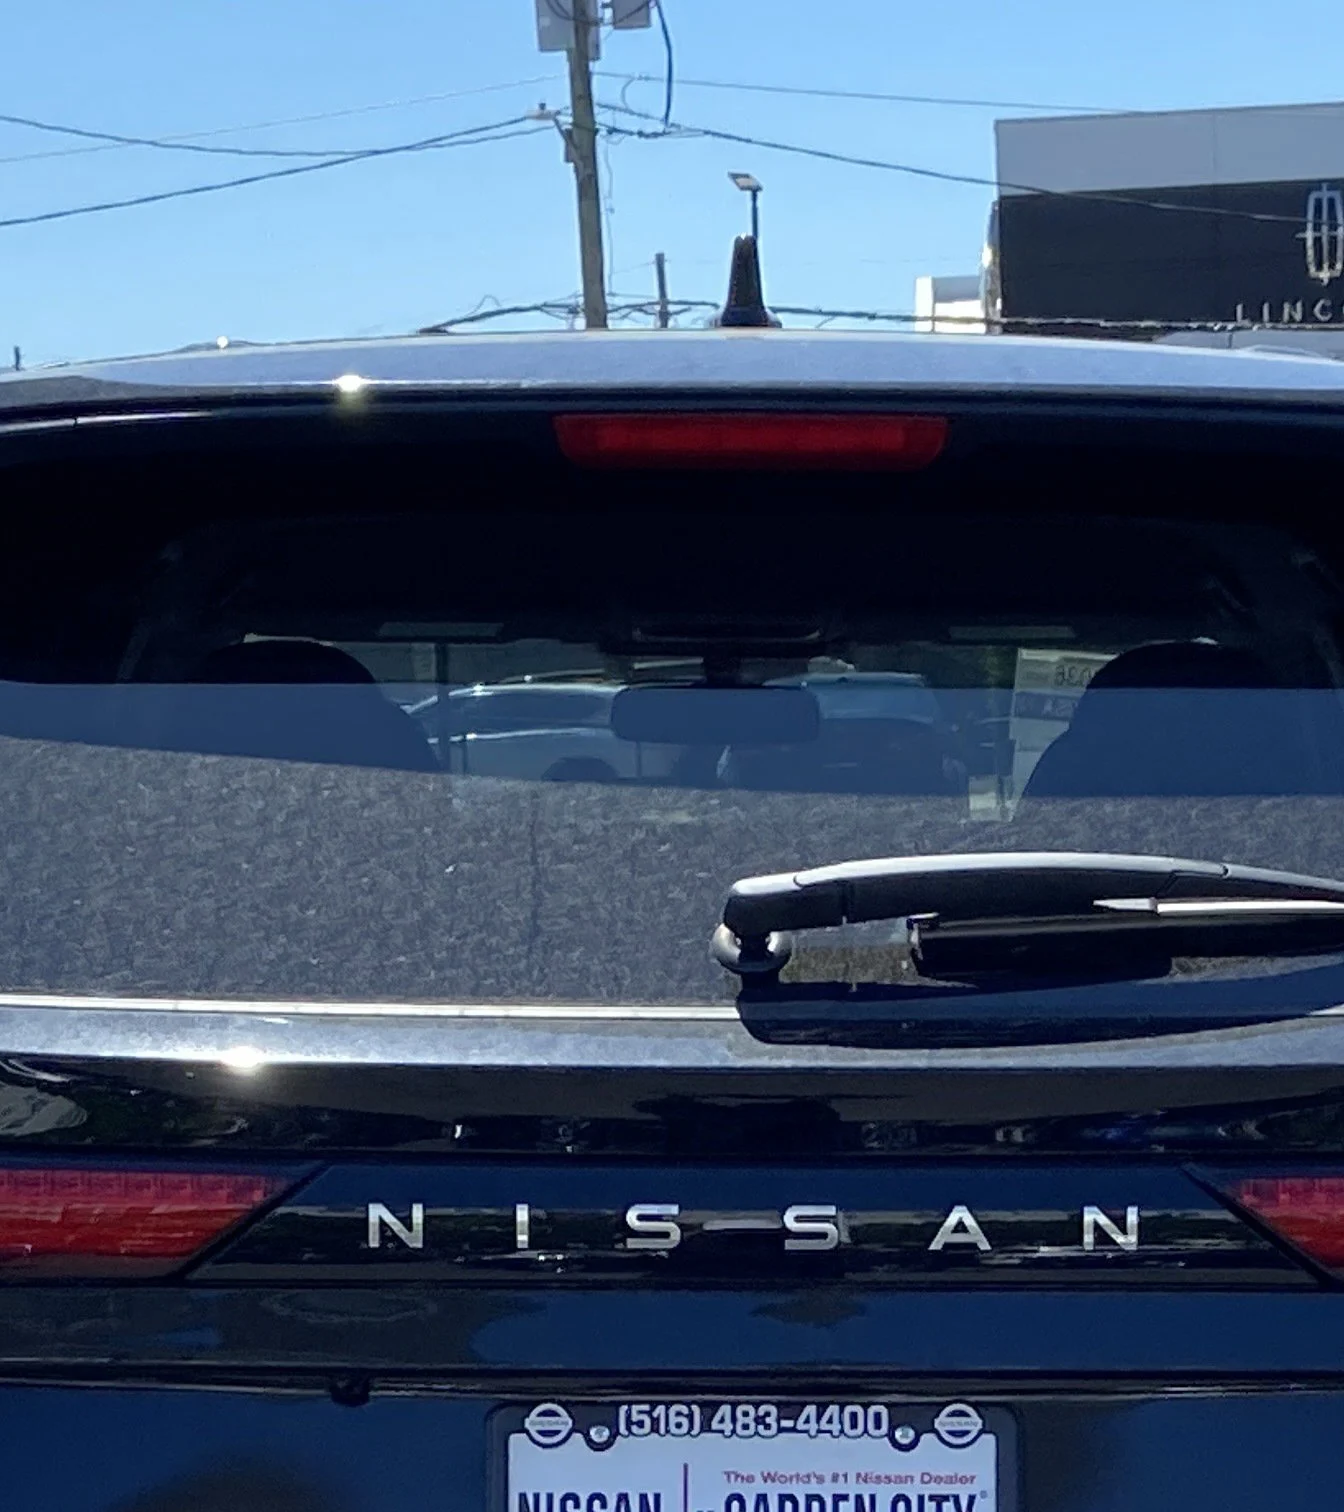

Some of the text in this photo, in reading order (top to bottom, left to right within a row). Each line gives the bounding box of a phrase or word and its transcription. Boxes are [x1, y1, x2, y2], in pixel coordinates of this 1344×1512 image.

[367, 1202, 1139, 1251] NISSAN
[618, 1404, 889, 1438] (516) 483-4400
[723, 1470, 977, 1486] The World's #1 Nissan Dealer
